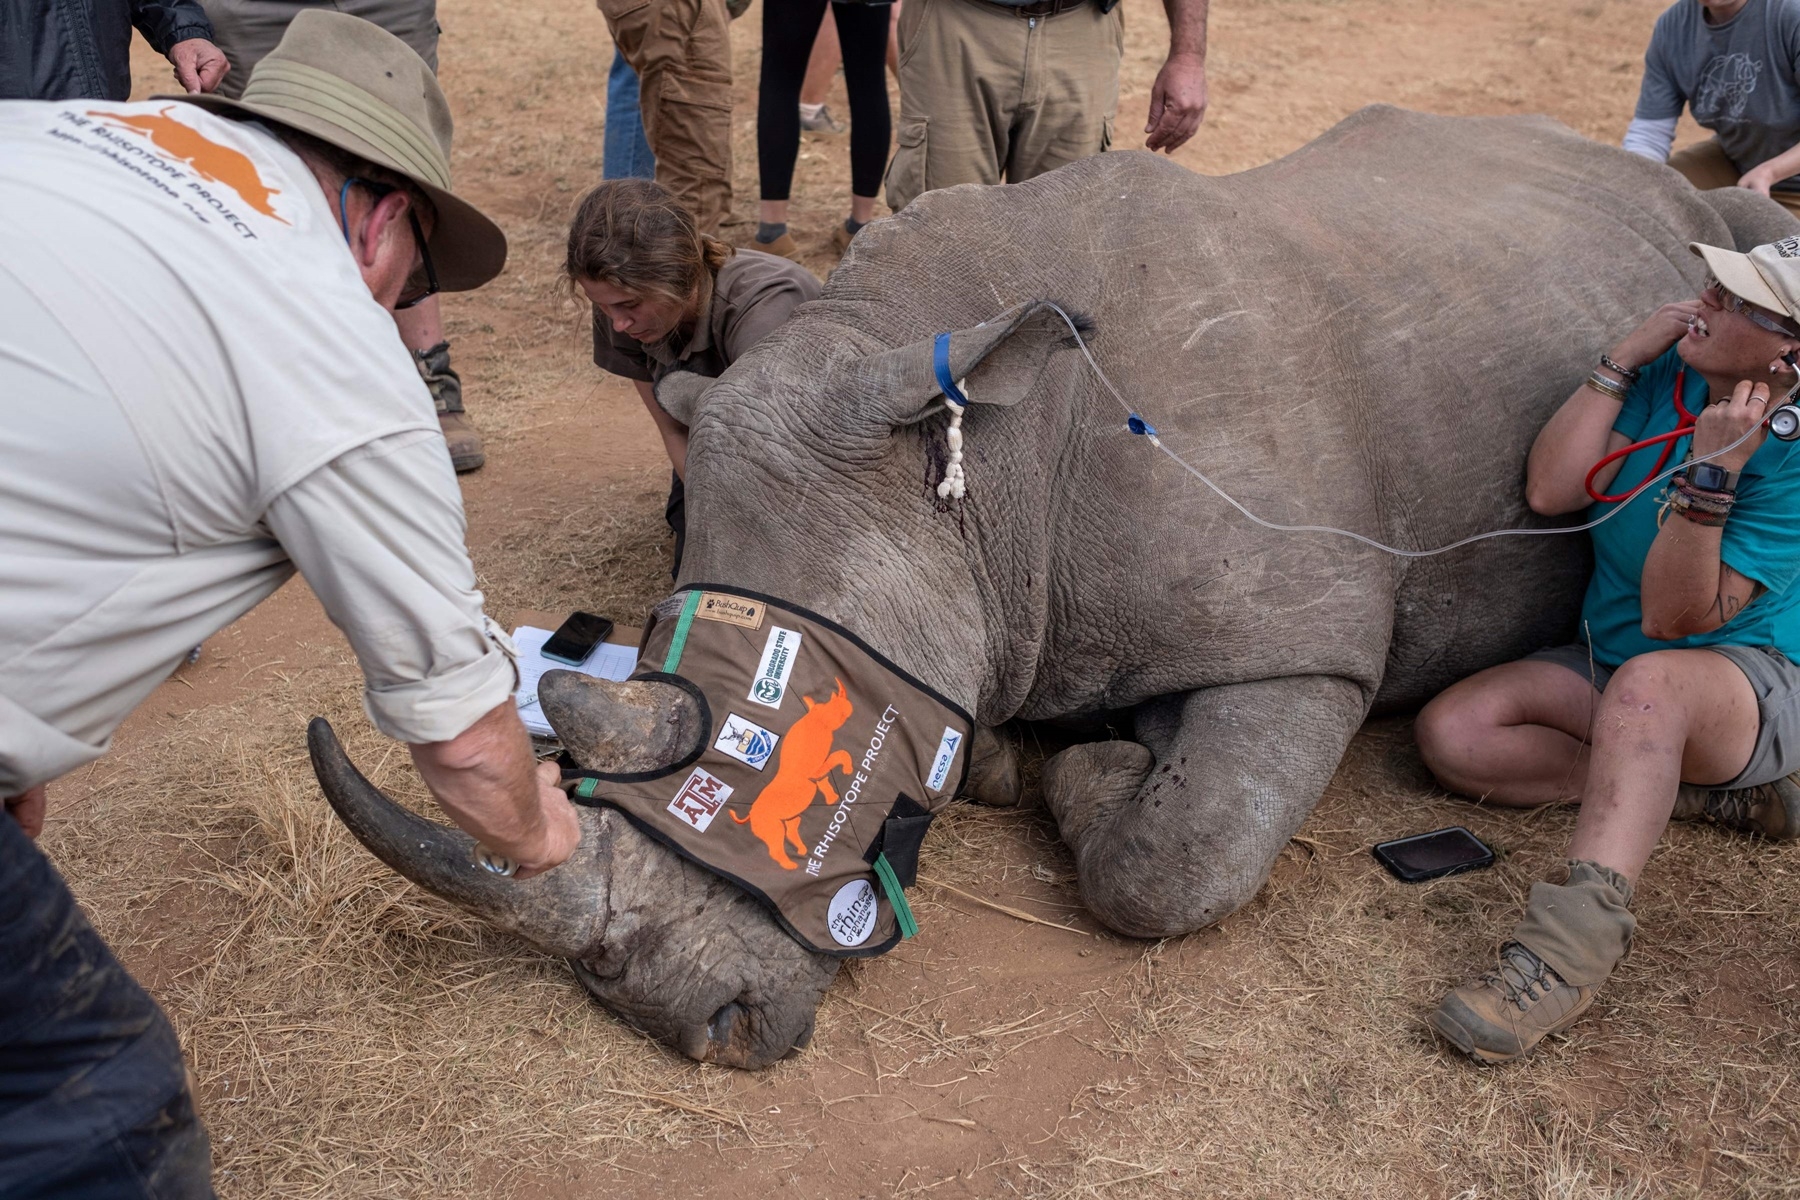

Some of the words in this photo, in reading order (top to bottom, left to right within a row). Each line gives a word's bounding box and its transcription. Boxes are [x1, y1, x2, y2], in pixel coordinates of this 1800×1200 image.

[58, 111, 93, 127] THE
[187, 182, 258, 240] PROJECT
[715, 600, 747, 614] BushQuip
[765, 649, 781, 678] COLORADO
[775, 630, 787, 649] STATE
[773, 647, 790, 680] UNIVERSITY
[862, 703, 899, 772] PROJECT
[932, 754, 948, 789] necsa
[814, 771, 868, 858] RHISOTOPE
[806, 857, 823, 877] THE
[831, 912, 843, 930] the
[846, 893, 874, 943] orphanage
